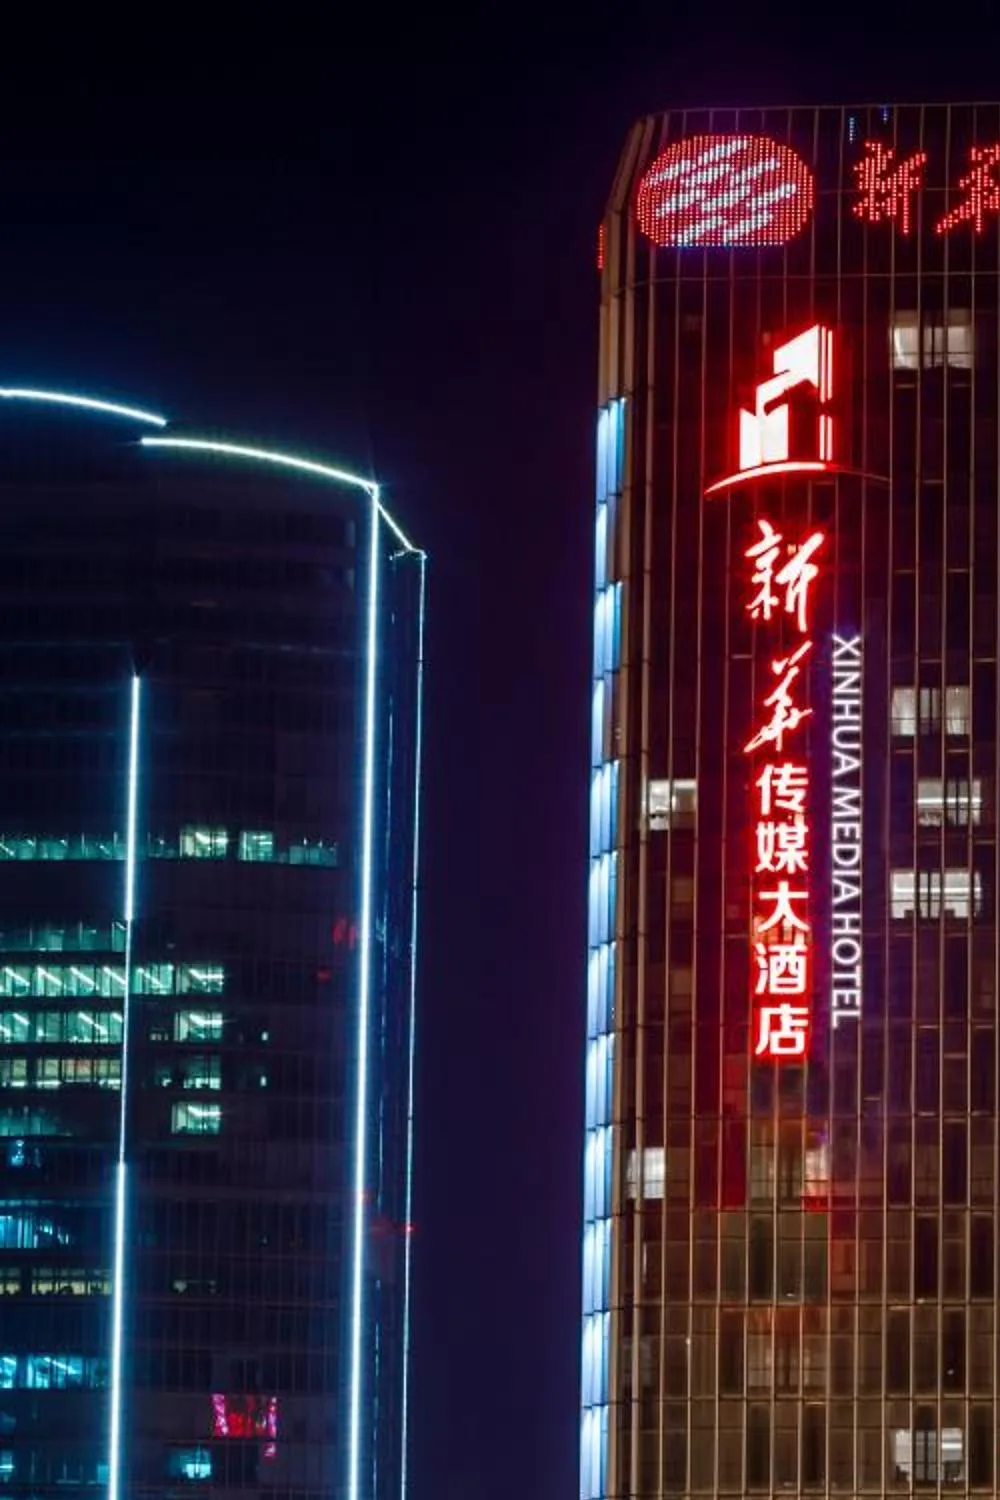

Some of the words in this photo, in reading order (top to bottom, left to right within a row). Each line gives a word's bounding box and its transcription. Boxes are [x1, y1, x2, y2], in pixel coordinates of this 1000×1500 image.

[831, 634, 862, 776] XINHUA
[831, 786, 862, 904] MEDIA
[831, 912, 862, 1028] HOTEL
